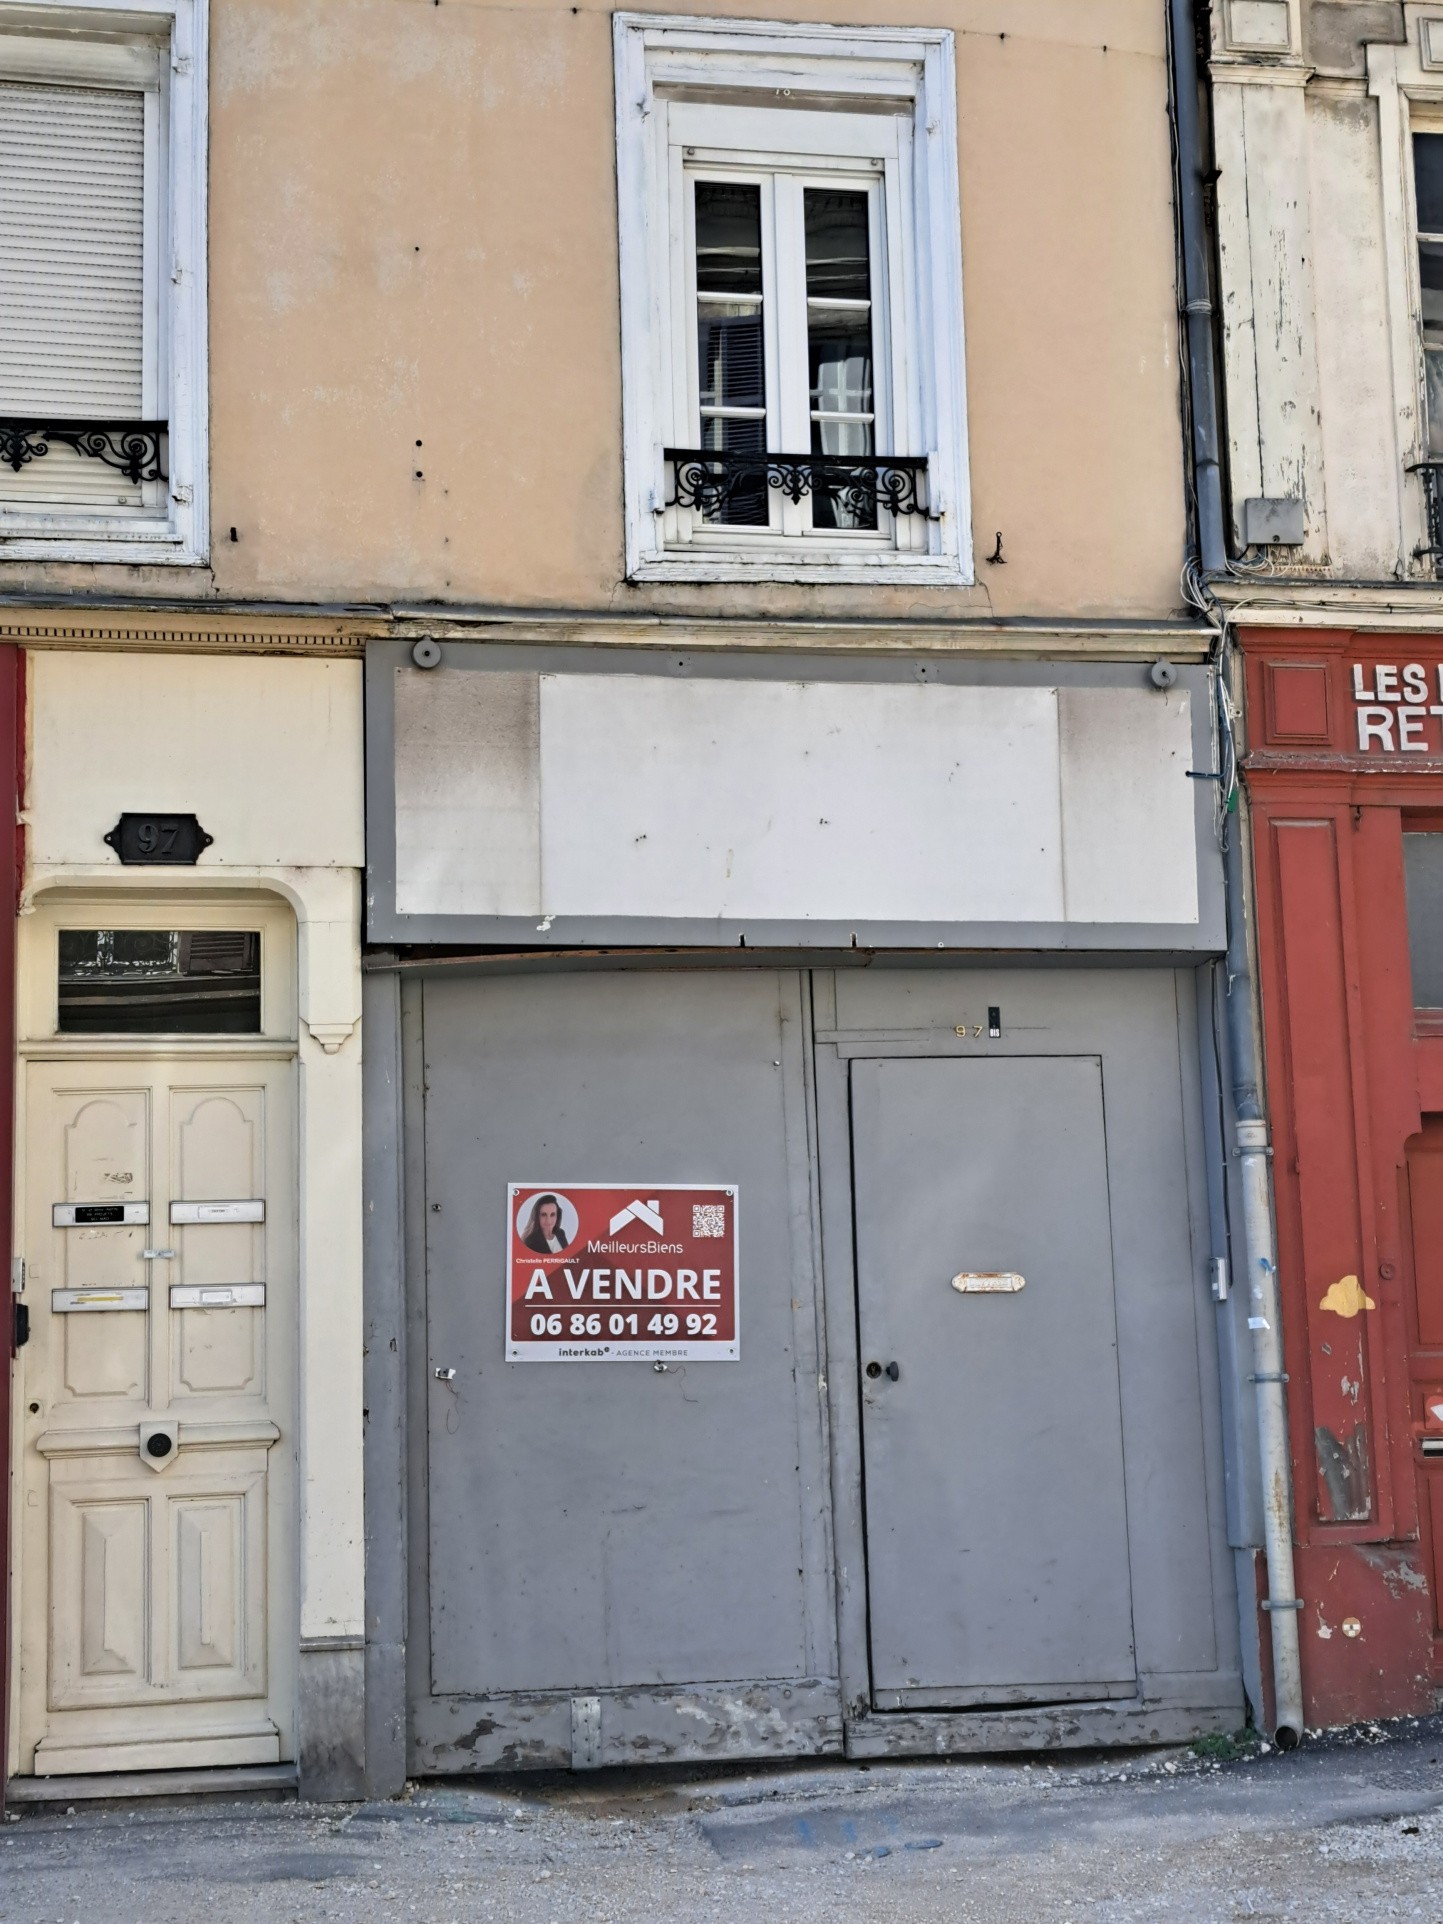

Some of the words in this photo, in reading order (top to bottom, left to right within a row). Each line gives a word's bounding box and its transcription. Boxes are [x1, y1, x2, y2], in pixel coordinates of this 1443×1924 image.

[1353, 663, 1428, 703] LES
[138, 823, 178, 854] 97
[955, 1025, 983, 1038] 97
[587, 1240, 684, 1254] MeilleursBiens
[524, 1268, 554, 1300] A
[563, 1269, 721, 1300] VENDRE
[530, 1313, 563, 1336] 06
[569, 1313, 602, 1336] 86
[608, 1313, 638, 1336] 01
[647, 1313, 679, 1336] 49
[685, 1313, 718, 1336] 92
